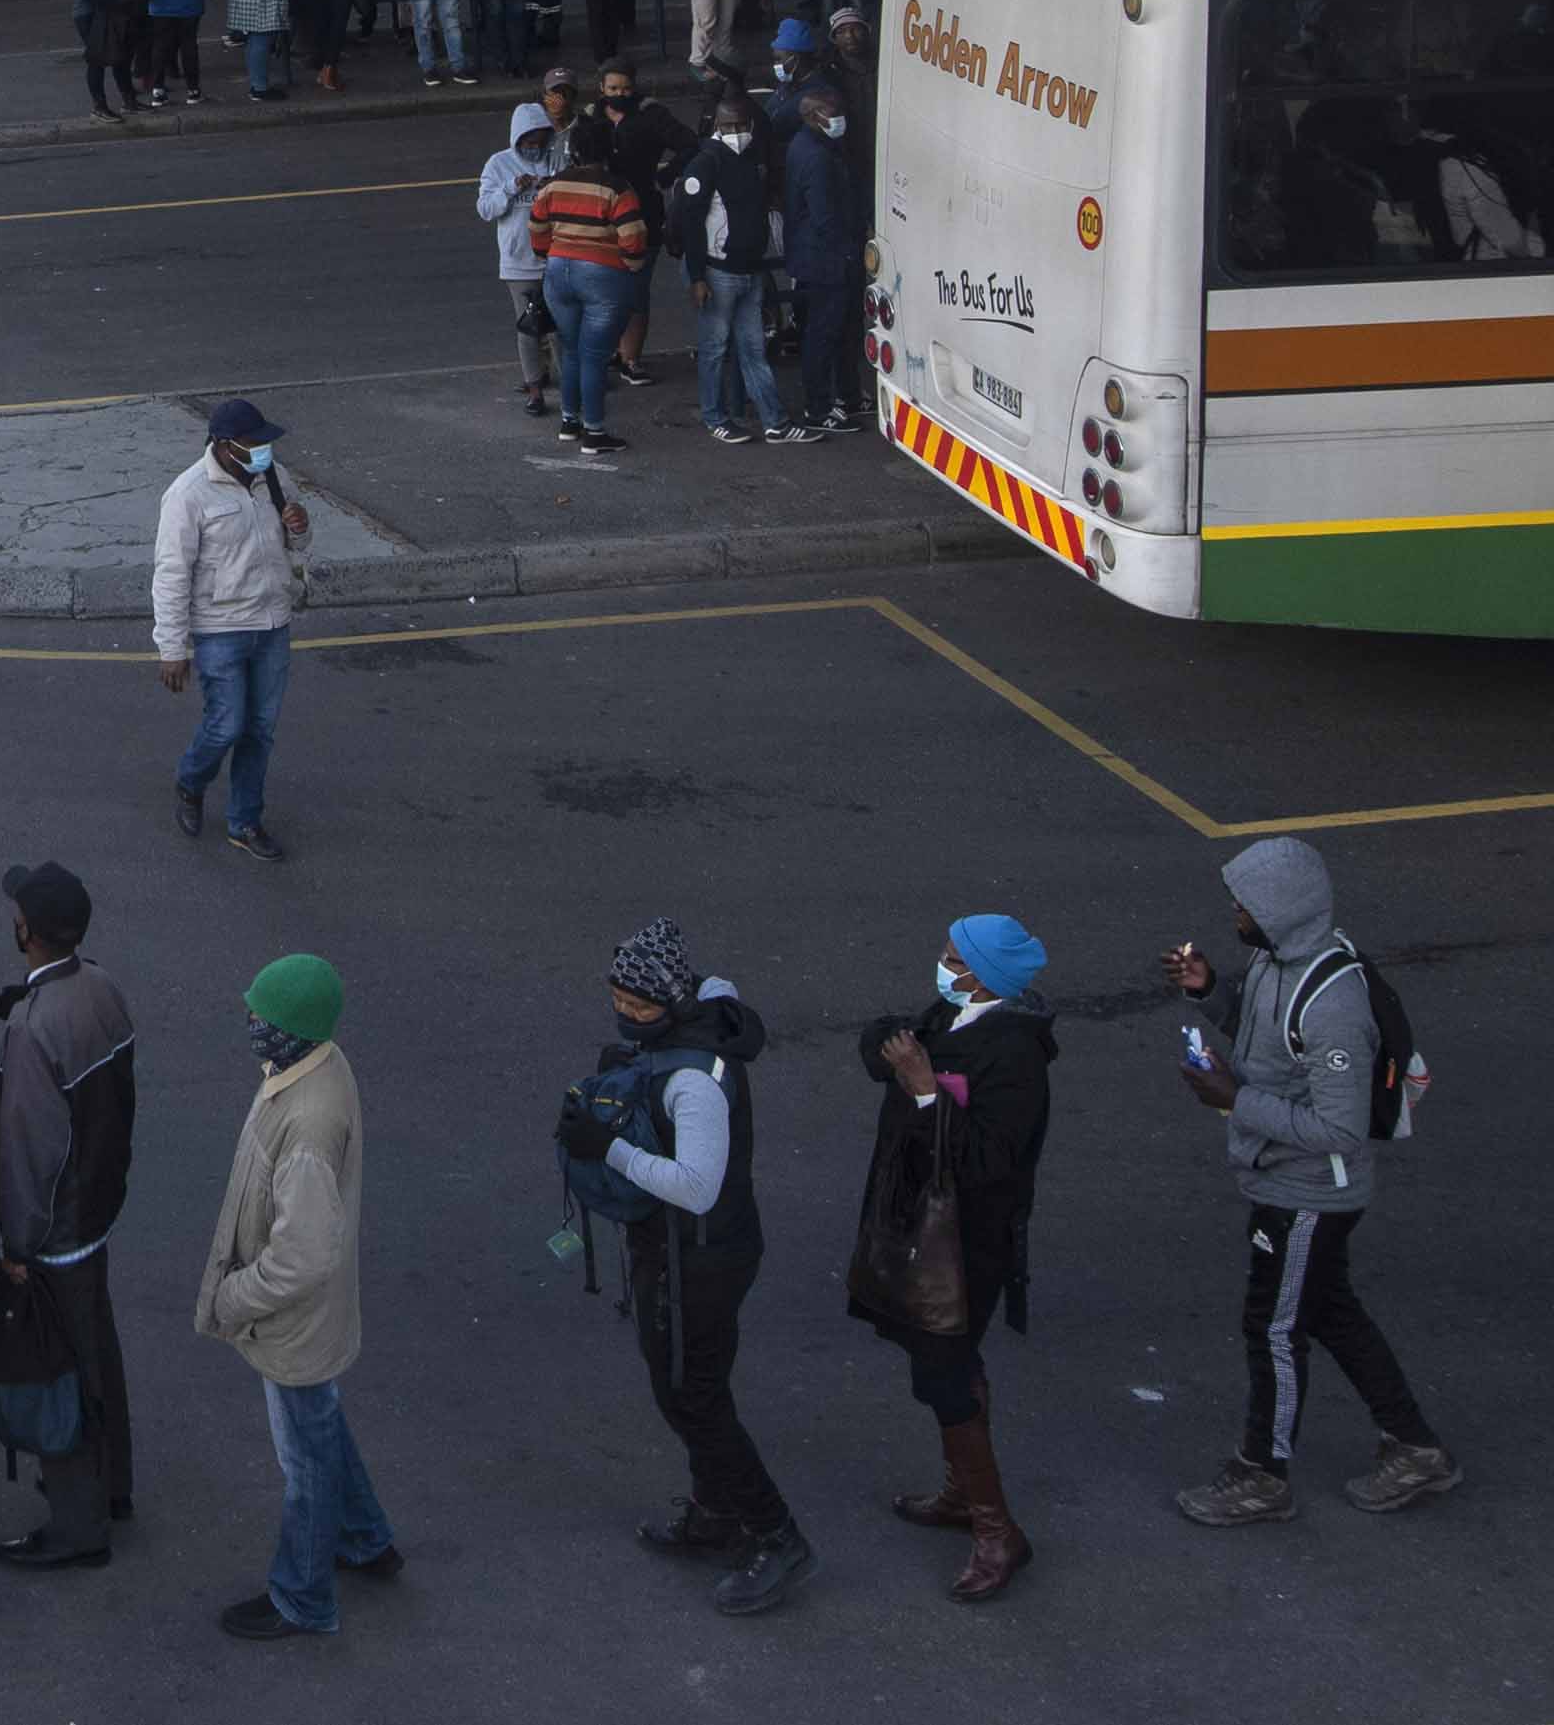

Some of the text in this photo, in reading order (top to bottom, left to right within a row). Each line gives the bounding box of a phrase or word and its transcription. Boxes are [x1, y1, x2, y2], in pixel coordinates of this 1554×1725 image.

[995, 40, 1099, 130] Arrow
[1081, 211, 1099, 236] 100
[934, 269, 1035, 319] The Bus For Us
[973, 367, 1020, 413] CA 983-884
